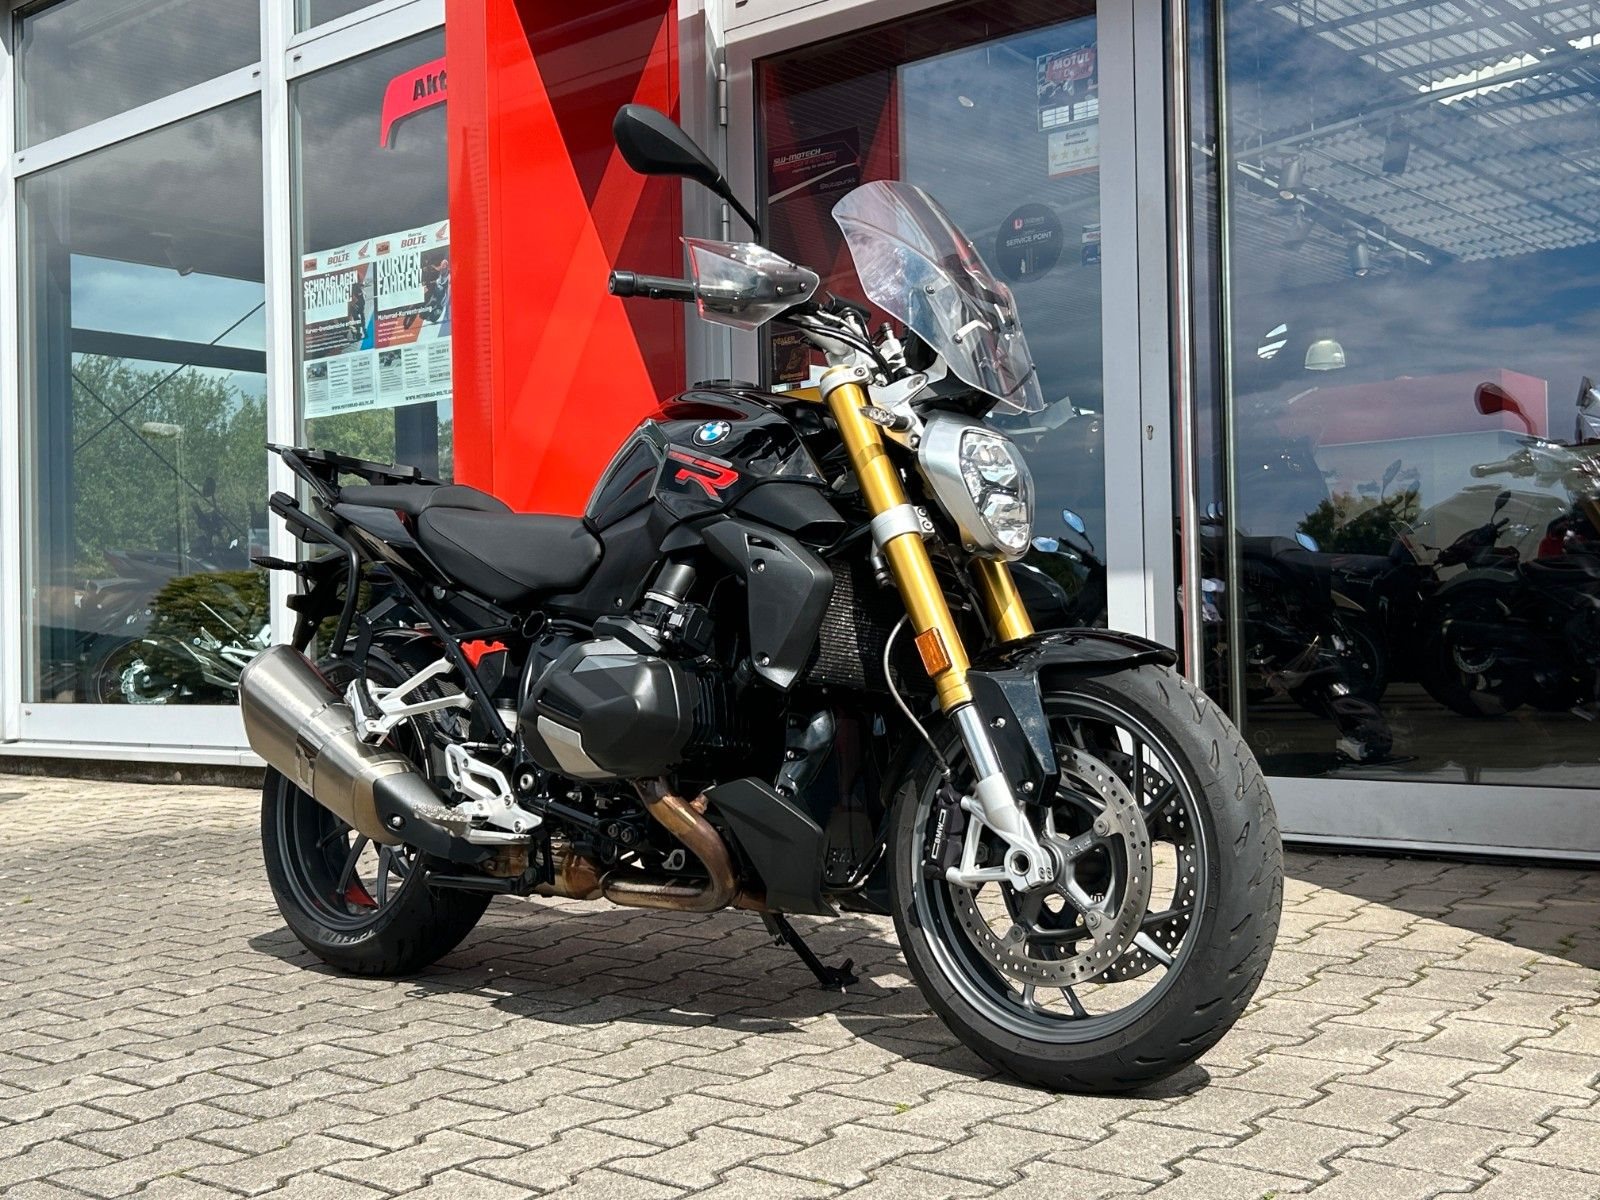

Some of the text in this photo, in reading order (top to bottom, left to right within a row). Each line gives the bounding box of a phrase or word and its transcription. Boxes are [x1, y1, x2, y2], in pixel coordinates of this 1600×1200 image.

[1053, 53, 1091, 70] MOTUL
[773, 148, 821, 165] SW-MOTECH
[401, 235, 428, 249] BOLTE
[1006, 236, 1032, 247] SERVICE
[1033, 231, 1053, 241] POINT
[327, 253, 350, 266] BOLTE
[376, 252, 422, 278] KURVEN
[303, 270, 358, 293] SCHRÄGLAGEN
[377, 269, 423, 296] FAHREN!
[303, 283, 353, 310] TRAINING!
[934, 821, 944, 844] BMW
